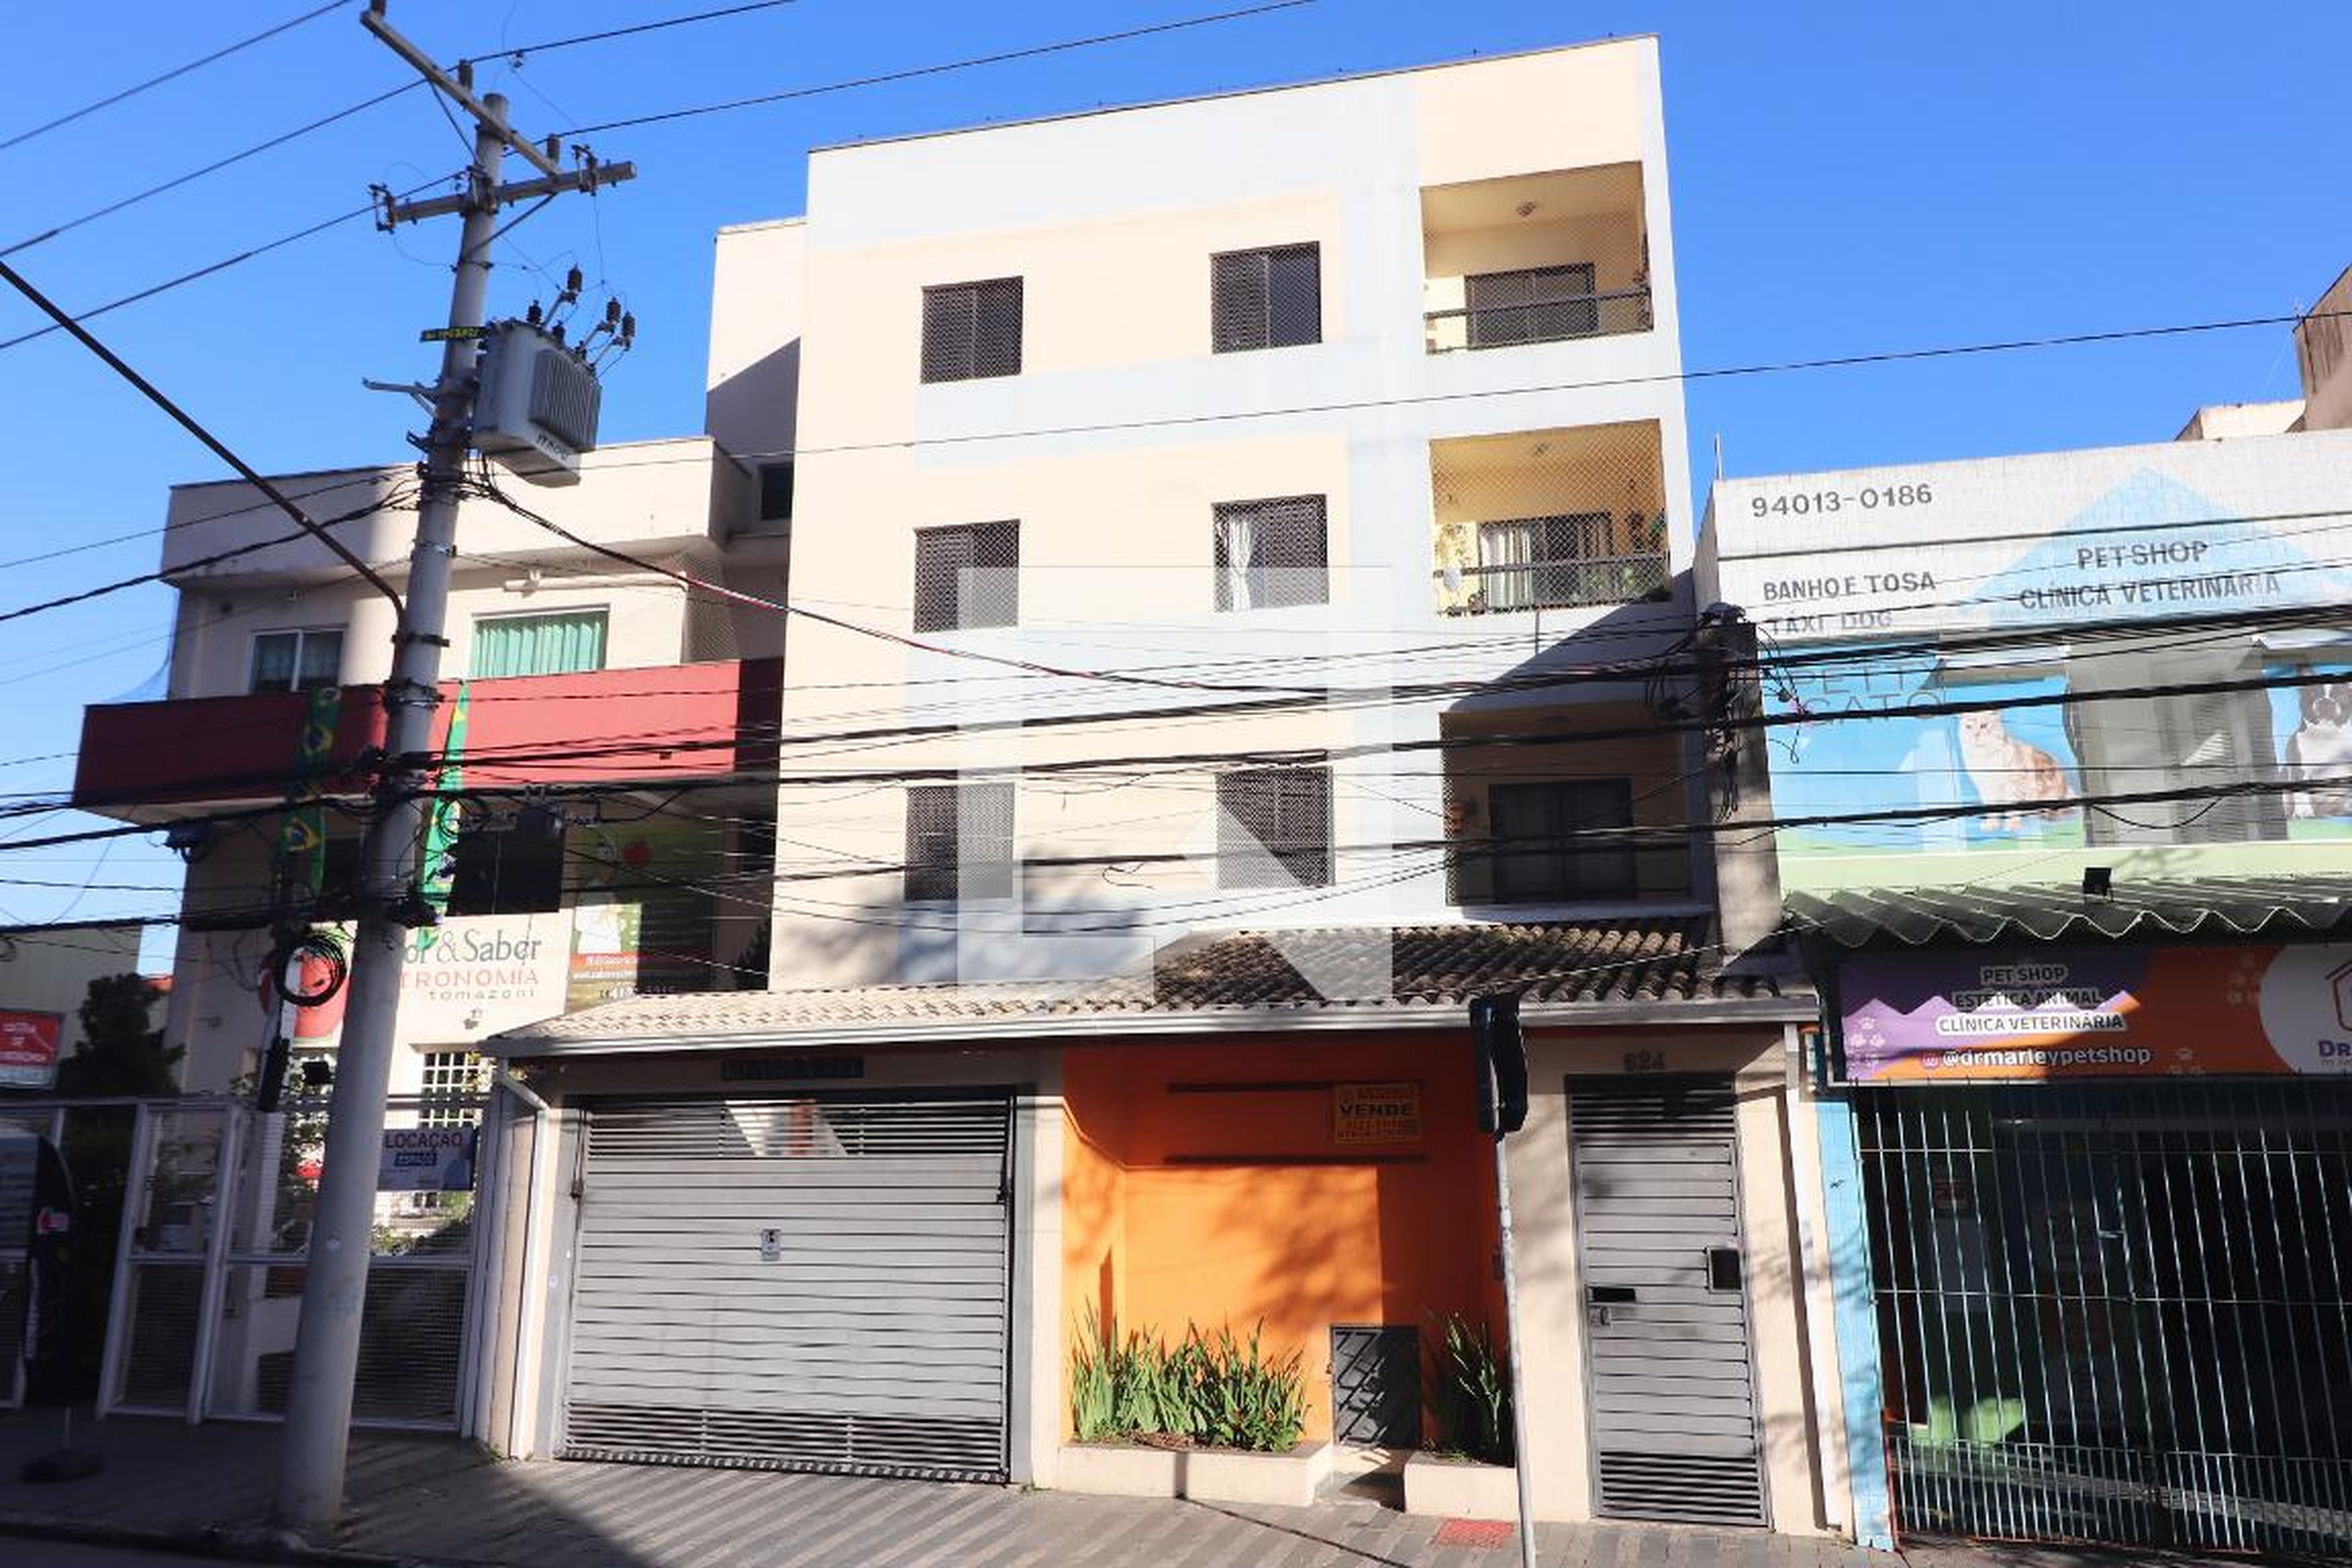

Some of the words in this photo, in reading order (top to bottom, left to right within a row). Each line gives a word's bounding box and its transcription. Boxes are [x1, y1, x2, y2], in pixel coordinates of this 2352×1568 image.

[1752, 483, 1932, 517] 94013-0186
[1763, 577, 1841, 601] BANHO
[1844, 576, 1856, 595] E
[1864, 571, 1937, 593] TOSA
[400, 968, 538, 989] TRONOMIA
[1983, 968, 2013, 982] PET
[2015, 967, 2065, 981] SHOP
[2035, 987, 2101, 1005] ANIMAL
[1939, 1013, 2005, 1032] CLÍNICA
[2008, 1011, 2124, 1030] VETERINÁRIA
[1942, 1046, 2152, 1066] @drmarleypetshop
